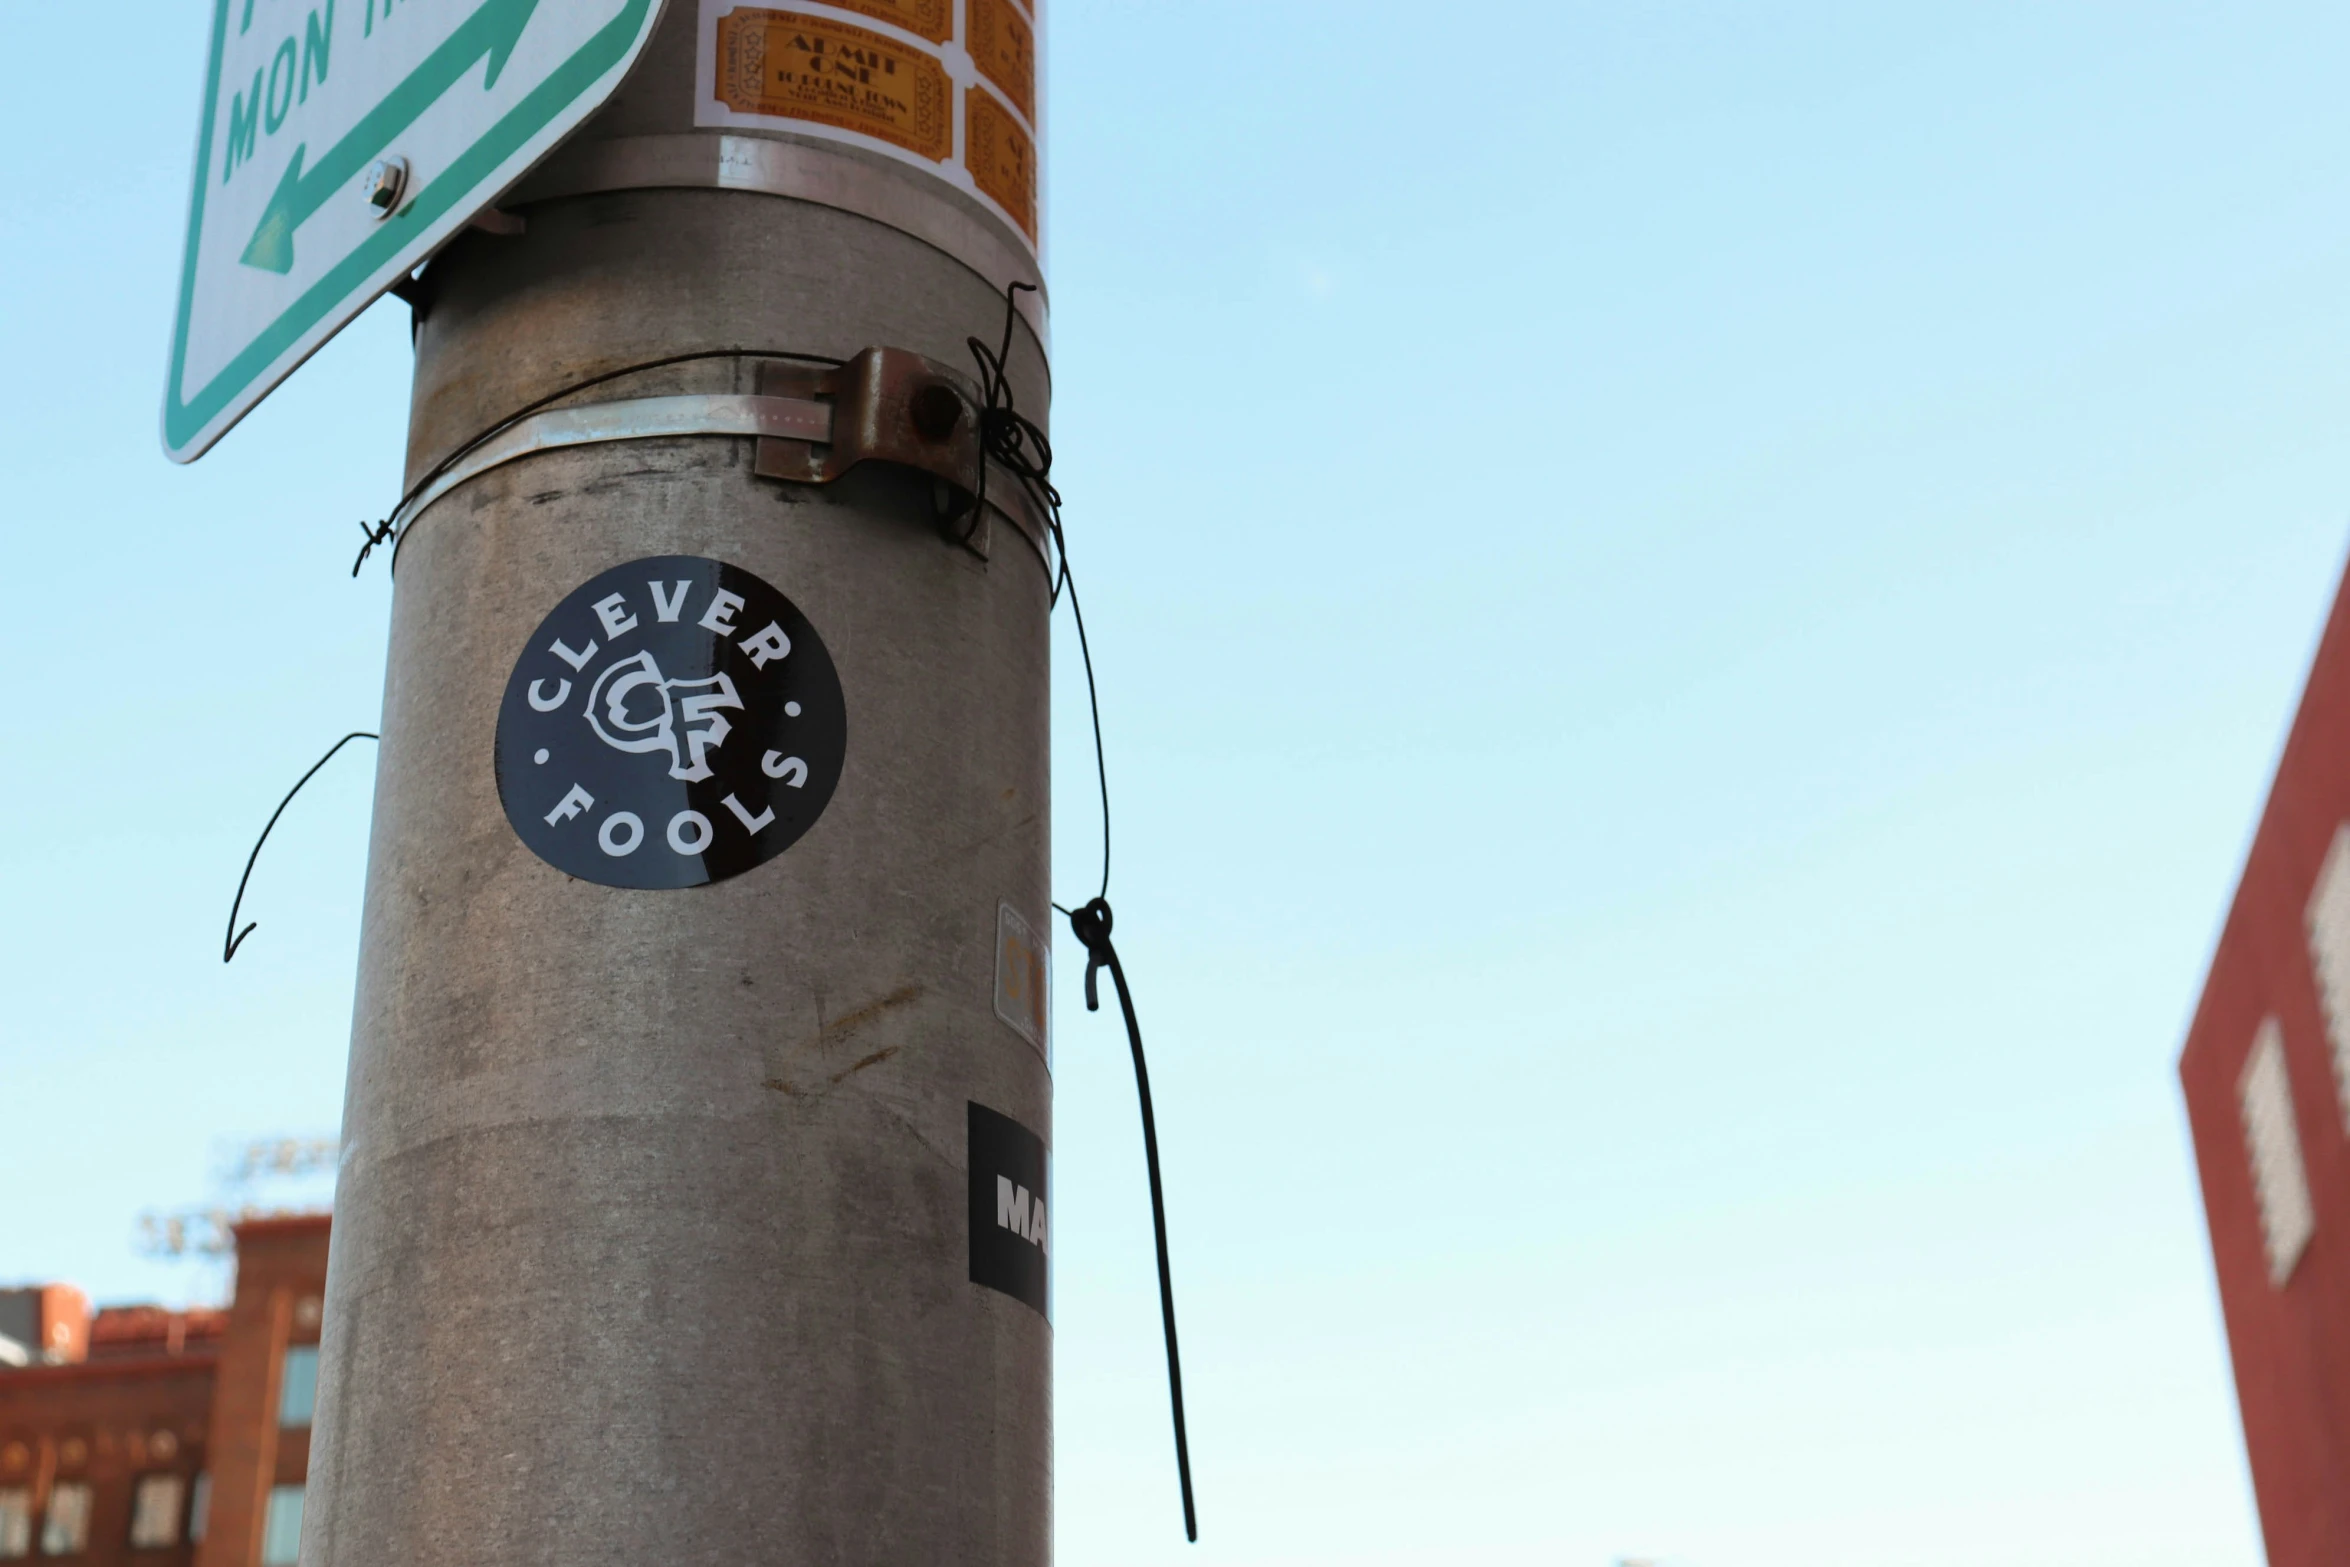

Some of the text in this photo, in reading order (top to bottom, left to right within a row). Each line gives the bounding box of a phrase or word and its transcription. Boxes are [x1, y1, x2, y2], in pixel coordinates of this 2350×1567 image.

[224, 0, 334, 185] MON
[785, 33, 899, 76] ADMIT
[809, 55, 878, 88] ONE
[527, 579, 792, 713] CLEVER
[543, 749, 809, 858] FOOLS
